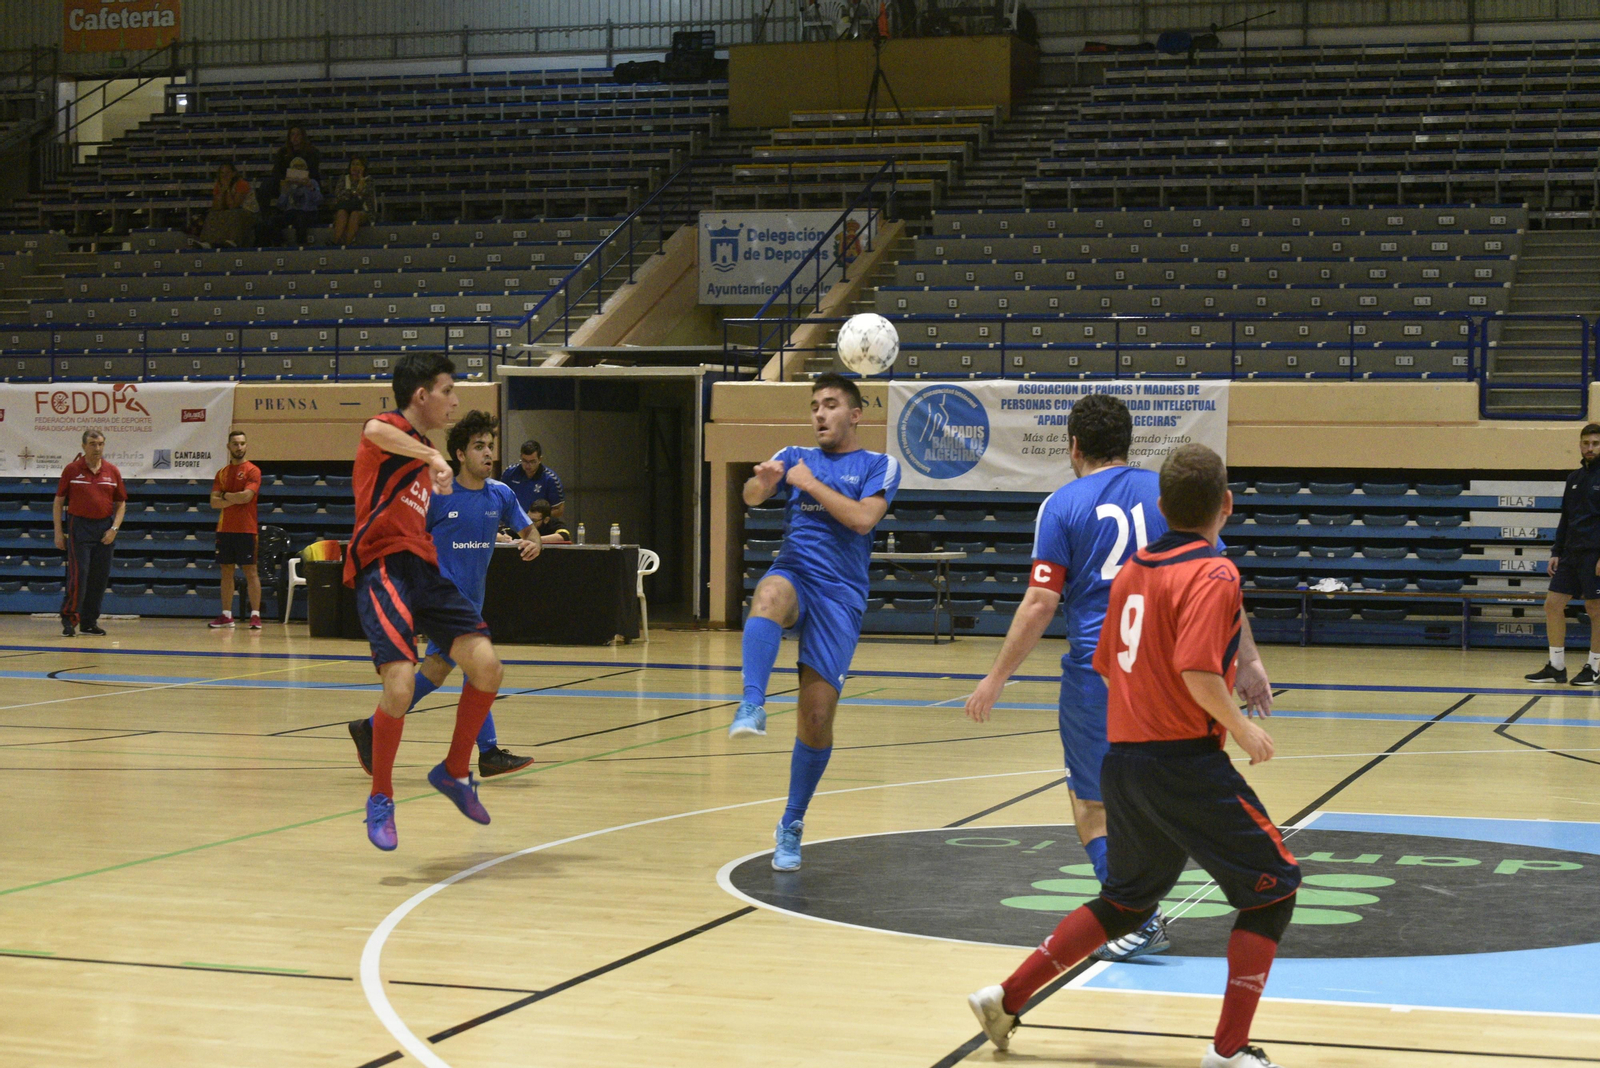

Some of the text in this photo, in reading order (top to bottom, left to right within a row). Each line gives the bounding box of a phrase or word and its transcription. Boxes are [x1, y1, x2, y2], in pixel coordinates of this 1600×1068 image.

[69, 3, 174, 31] Cafetería
[747, 228, 826, 244] Delegación
[744, 248, 760, 260] de
[796, 284, 808, 294] de
[1018, 384, 1200, 395] ASOCIACIÓN DE PADRES Y MADRES DE
[255, 398, 318, 410] PRENSA
[1001, 399, 1052, 410] PERSONAS
[1054, 399, 1074, 410] CON
[1153, 400, 1216, 411] INTELECTUAL
[944, 425, 984, 438] APADIS
[970, 438, 984, 450] DE
[1022, 433, 1043, 442] Más
[1047, 433, 1058, 442] de
[1162, 434, 1191, 445] junto
[924, 448, 983, 461] ALGECIRAS
[1031, 446, 1046, 454] las
[800, 502, 826, 512] bank
[1500, 496, 1534, 506] FILA 5
[1502, 528, 1536, 537] FILA 4
[1096, 502, 1148, 580] 21
[1500, 560, 1536, 570] FILA 3
[1034, 564, 1052, 583] C
[1117, 594, 1145, 673] 9
[1498, 625, 1532, 633] FILA 1
